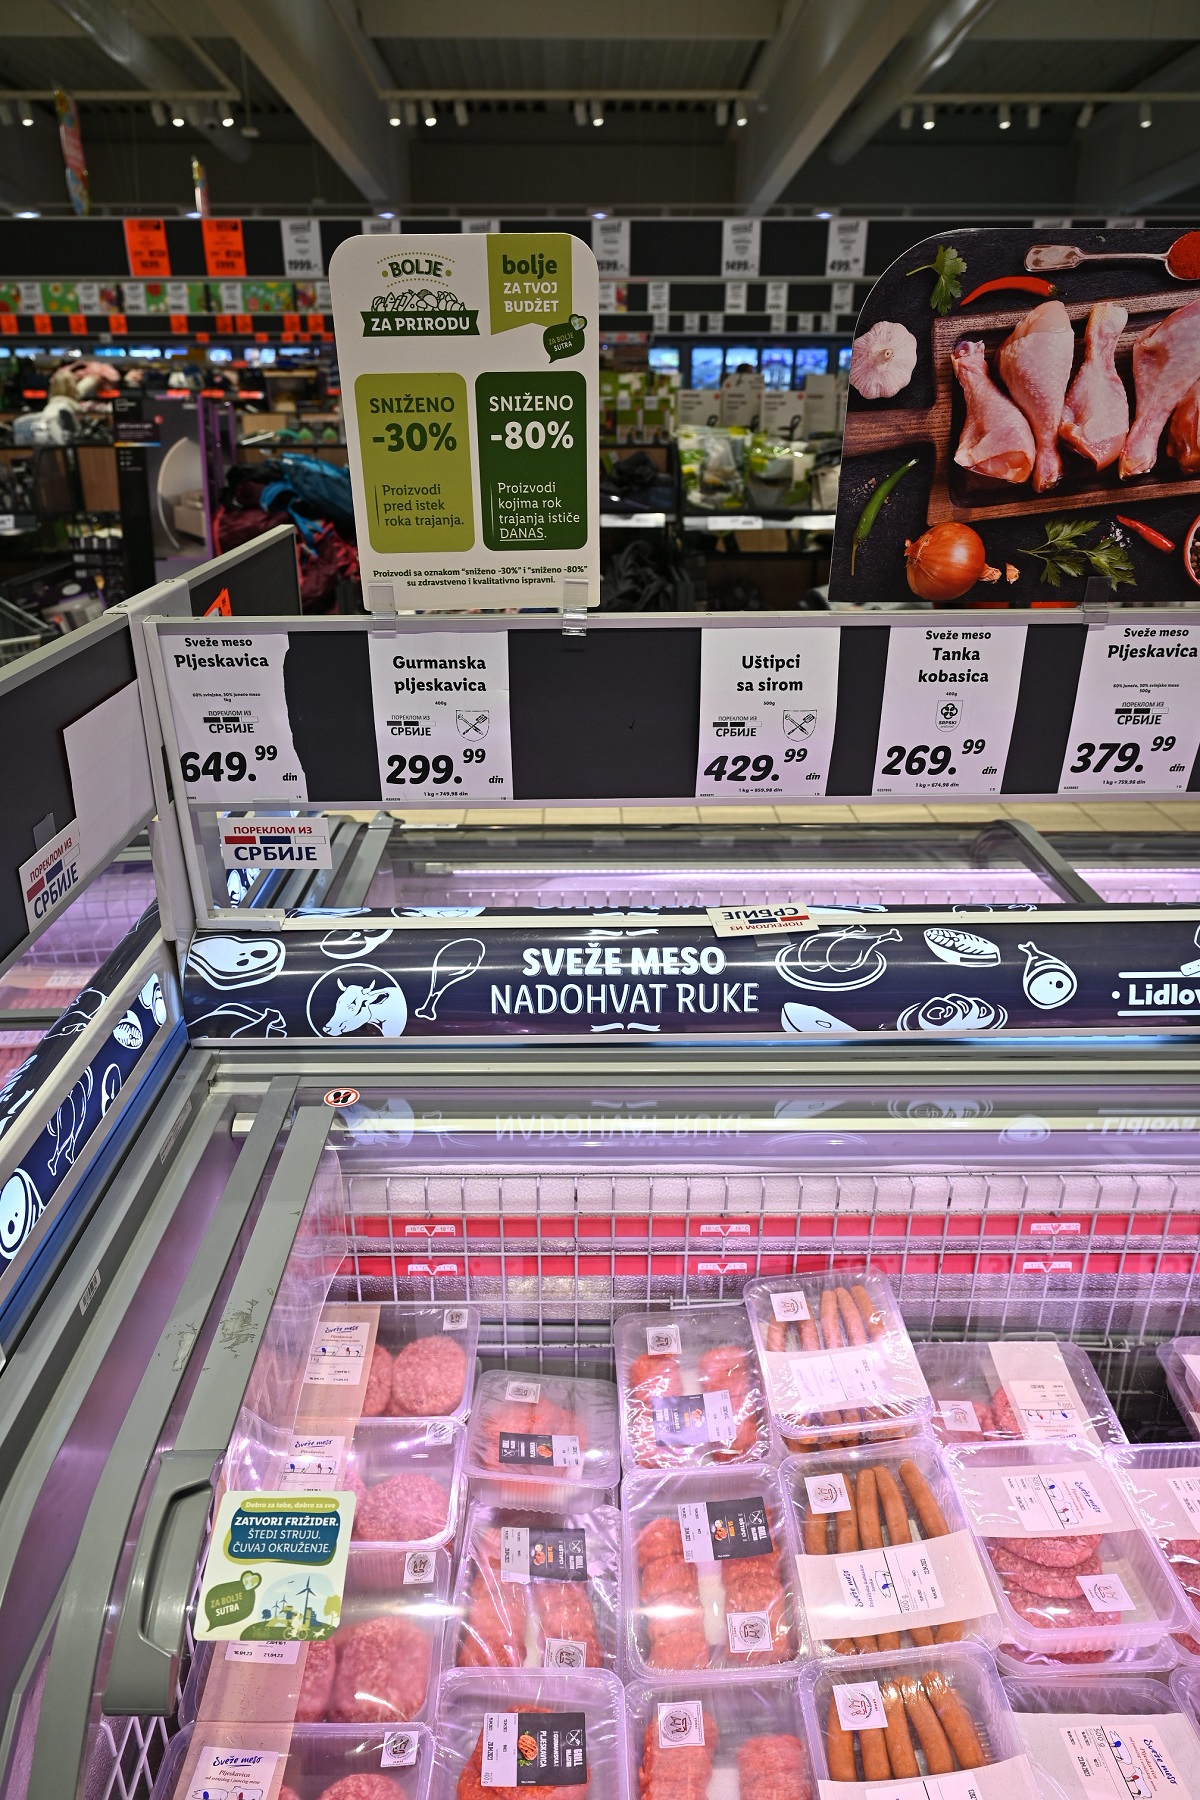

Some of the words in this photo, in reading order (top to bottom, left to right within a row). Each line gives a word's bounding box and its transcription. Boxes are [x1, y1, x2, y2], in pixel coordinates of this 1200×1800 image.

[388, 258, 444, 279] BOLJE
[502, 254, 558, 279] bolje
[504, 282, 521, 295] ZA
[524, 282, 558, 295] TVOJ
[504, 298, 559, 313] BUDŽET
[371, 318, 392, 332] ZA
[395, 317, 470, 331] PRIRODU
[548, 336, 558, 346] ZA
[557, 332, 574, 344] BOLJE
[553, 341, 573, 352] SUTRA
[370, 394, 455, 414] SNIŽENO
[489, 392, 574, 412] SNIŽENO
[372, 422, 457, 452] -30%
[490, 420, 574, 450] -80%
[382, 484, 441, 497] Proizvodi
[498, 482, 556, 494] Proizvodi
[384, 499, 413, 514] pred
[415, 498, 445, 511] istek
[498, 498, 539, 512] kojima
[542, 497, 562, 508] rok
[385, 515, 412, 527] roka
[414, 514, 465, 529] trajanja.
[499, 513, 545, 527] trajanja
[548, 512, 580, 523] ističe
[500, 528, 547, 540] DANAS.
[373, 569, 412, 578] Proizvodi
[424, 568, 460, 577] oznakom
[418, 578, 467, 587] zdravstveno
[472, 577, 520, 586] kvalitativno
[522, 576, 556, 586] ispravni.
[926, 630, 959, 641] Sveže
[962, 631, 992, 640] meso
[1124, 627, 1157, 638] Sveže
[1159, 628, 1190, 637] meso
[184, 637, 218, 648] Sveže
[222, 639, 253, 647] meso
[933, 647, 981, 661] Tanka
[1108, 643, 1198, 661] Pljeskavica
[174, 653, 270, 671] Pljeskavica
[392, 656, 487, 670] Gurmanska
[742, 654, 801, 673] Uštipci
[918, 669, 989, 683] kobasica
[394, 677, 487, 695] pljeskavica
[737, 681, 754, 692] sa
[758, 677, 803, 691] sirom
[1117, 715, 1162, 725] СРБИЈЕ
[209, 723, 255, 734] СРБИЈЕ
[391, 727, 432, 737] СРБИЈЕ
[716, 728, 757, 737] СРБИЈЕ
[982, 766, 998, 775] din
[1170, 764, 1186, 773] din
[282, 773, 298, 782] din
[489, 776, 504, 785] din
[806, 773, 821, 781] din
[234, 826, 296, 834] ПОРЕКЛОМ
[298, 826, 313, 835] ИЗ
[30, 844, 64, 883] ПОРЕКЛОМ
[64, 837, 73, 852] ИЗ
[234, 846, 317, 861] СРБИЈЕ
[34, 862, 79, 919] СРБИЈЕ
[722, 907, 799, 920] СРБИЈЕ
[746, 922, 803, 930] ПОРЕКЛОМ
[522, 942, 624, 977] SVEŽE
[631, 946, 727, 976] MESO
[490, 984, 669, 1015] NADOHVAT
[678, 982, 760, 1014] RUKE
[234, 1517, 283, 1526] ZATVORI
[284, 1516, 339, 1526] FRIŽIDER.
[248, 1528, 277, 1539] ŠTEDI
[280, 1530, 321, 1539] STRUJU.
[233, 1541, 266, 1553] ČUVAJ
[268, 1541, 331, 1553] OKRUŽENJE.
[210, 1599, 221, 1609] ZA
[222, 1593, 243, 1605] BOLJE
[216, 1603, 240, 1617] SUTRA
[213, 1756, 239, 1767] Sveže
[241, 1756, 263, 1764] meso
[574, 1749, 583, 1767] GRILL
[1143, 1739, 1163, 1763] Sveže
[1160, 1765, 1178, 1785] meso
